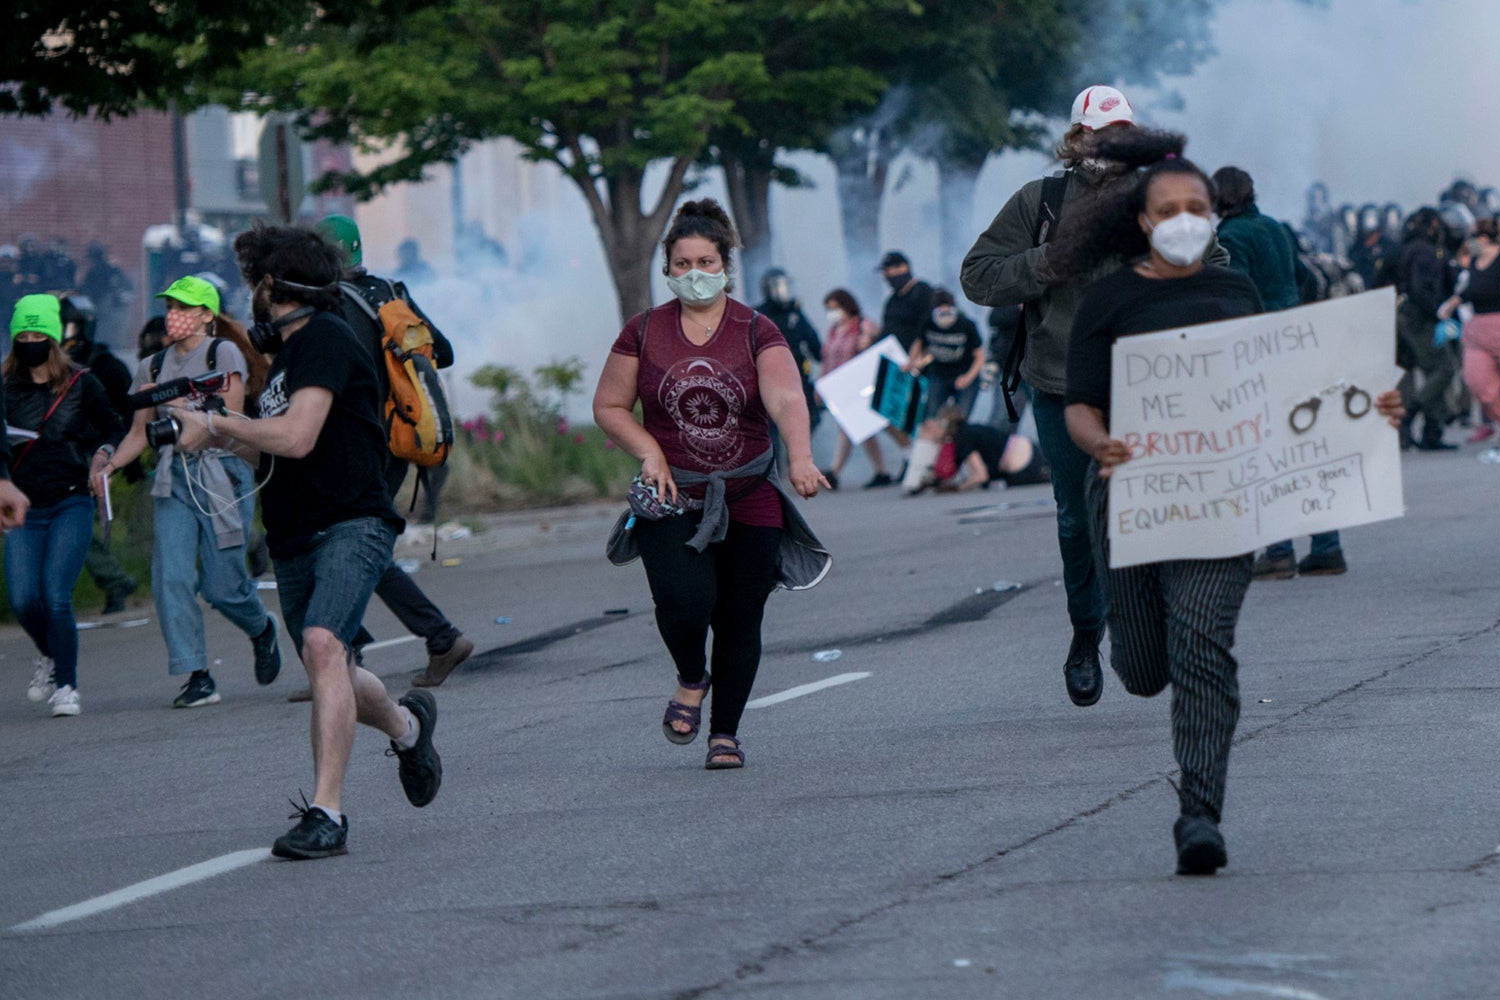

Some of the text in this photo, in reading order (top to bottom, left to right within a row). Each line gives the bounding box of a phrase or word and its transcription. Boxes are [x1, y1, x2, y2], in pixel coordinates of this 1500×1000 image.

[1125, 320, 1320, 387] DONT PUNISH
[1141, 372, 1267, 422] ME WITH
[1124, 402, 1272, 460] BRUTALITY!
[1118, 436, 1329, 499] TREAT US WITH
[1117, 489, 1250, 535] EQUALITY!
